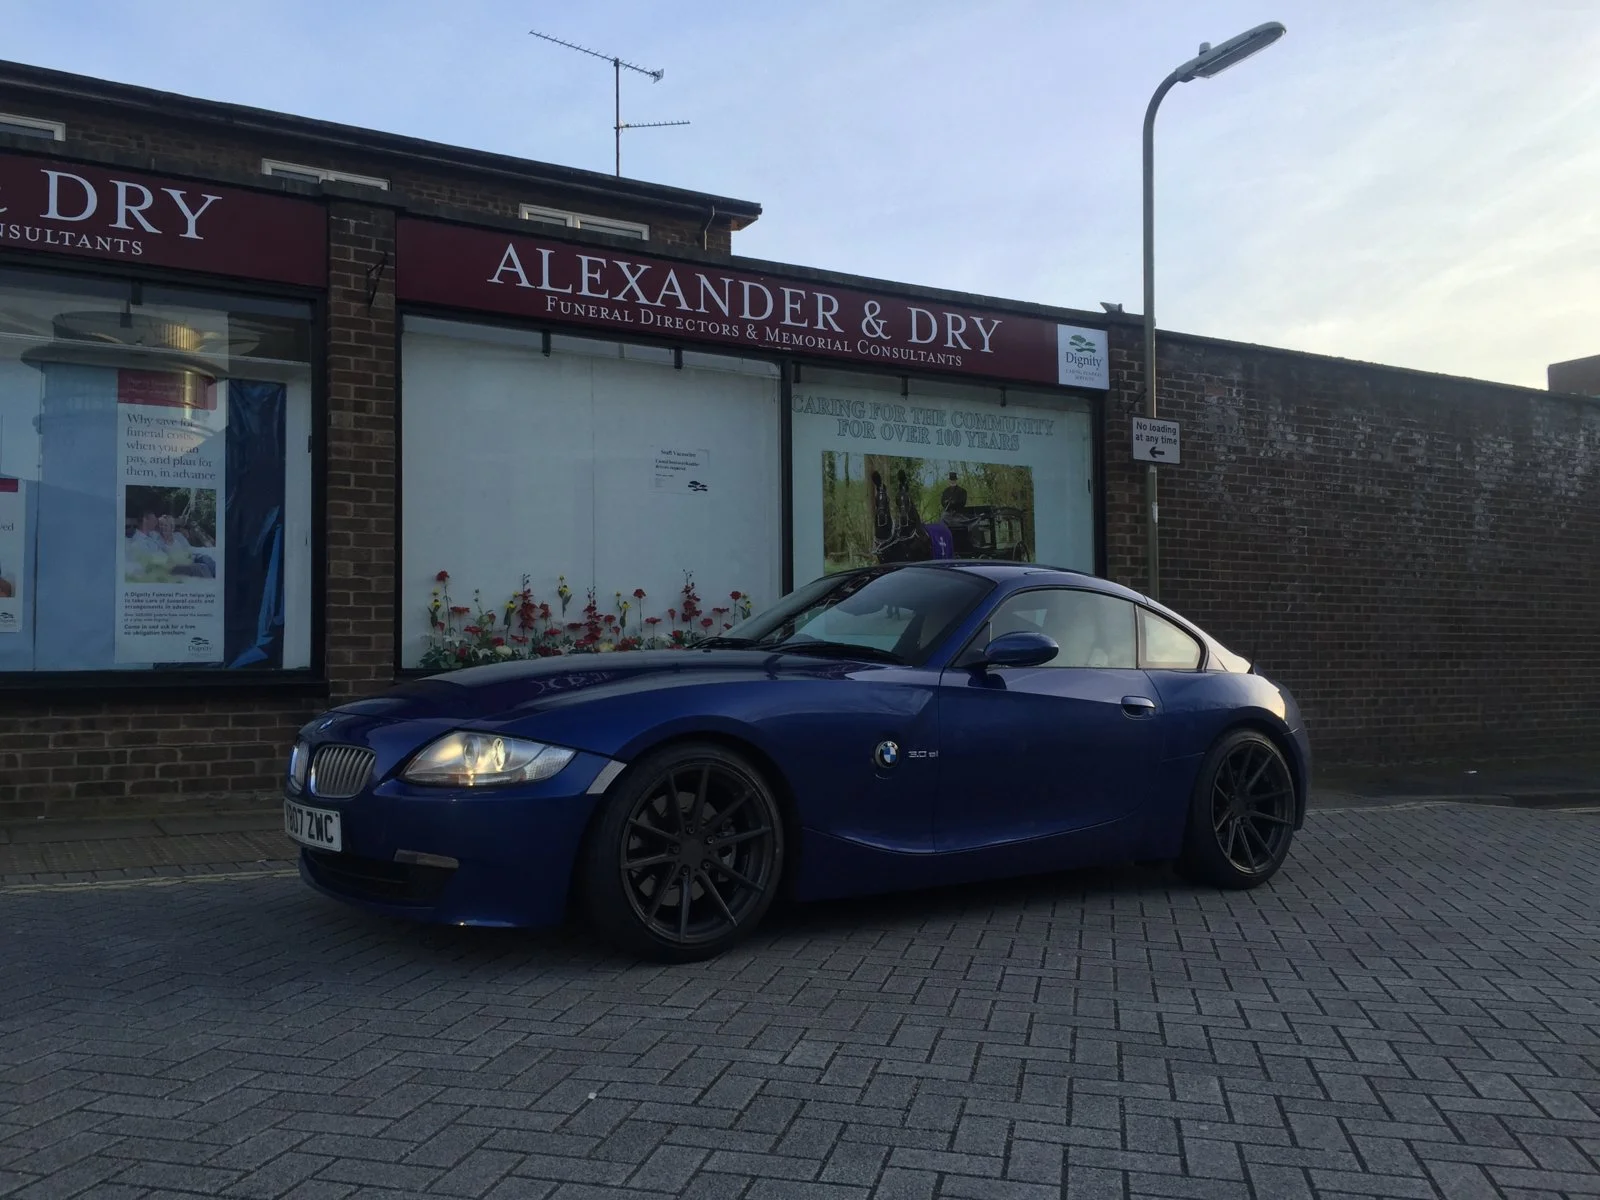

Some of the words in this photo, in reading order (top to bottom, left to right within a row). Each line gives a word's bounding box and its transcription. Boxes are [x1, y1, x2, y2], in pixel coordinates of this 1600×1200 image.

[40, 169, 222, 240] DRY
[487, 242, 844, 333] ALEXANDER
[861, 300, 891, 340] &
[907, 306, 1002, 353] DRY
[546, 295, 633, 323] FUNERAL
[640, 308, 739, 337] DIRECTORS
[746, 324, 758, 339] &
[765, 326, 852, 352] MEMORIAL
[857, 339, 962, 367] CONSULTANTS
[1065, 351, 1102, 371] Dignity
[127, 412, 153, 427] Why
[792, 394, 866, 419] CARING
[869, 402, 907, 423] FOR
[911, 407, 946, 427] THE
[951, 411, 1055, 436] COMMUNITY
[126, 426, 164, 439] funeral
[837, 419, 876, 439] FOR
[881, 423, 931, 444] OVER
[936, 428, 961, 447] 100
[965, 430, 1020, 451] YEARS
[1136, 421, 1148, 431] No
[1149, 422, 1177, 435] loading
[126, 440, 156, 451] when
[1135, 433, 1143, 441] at
[1145, 435, 1159, 444] any
[1161, 435, 1177, 445] time
[149, 455, 170, 465] and
[173, 455, 196, 468] plan
[198, 457, 213, 467] for
[160, 467, 170, 477] in
[172, 468, 216, 480] advance
[306, 810, 334, 843] ZWC
